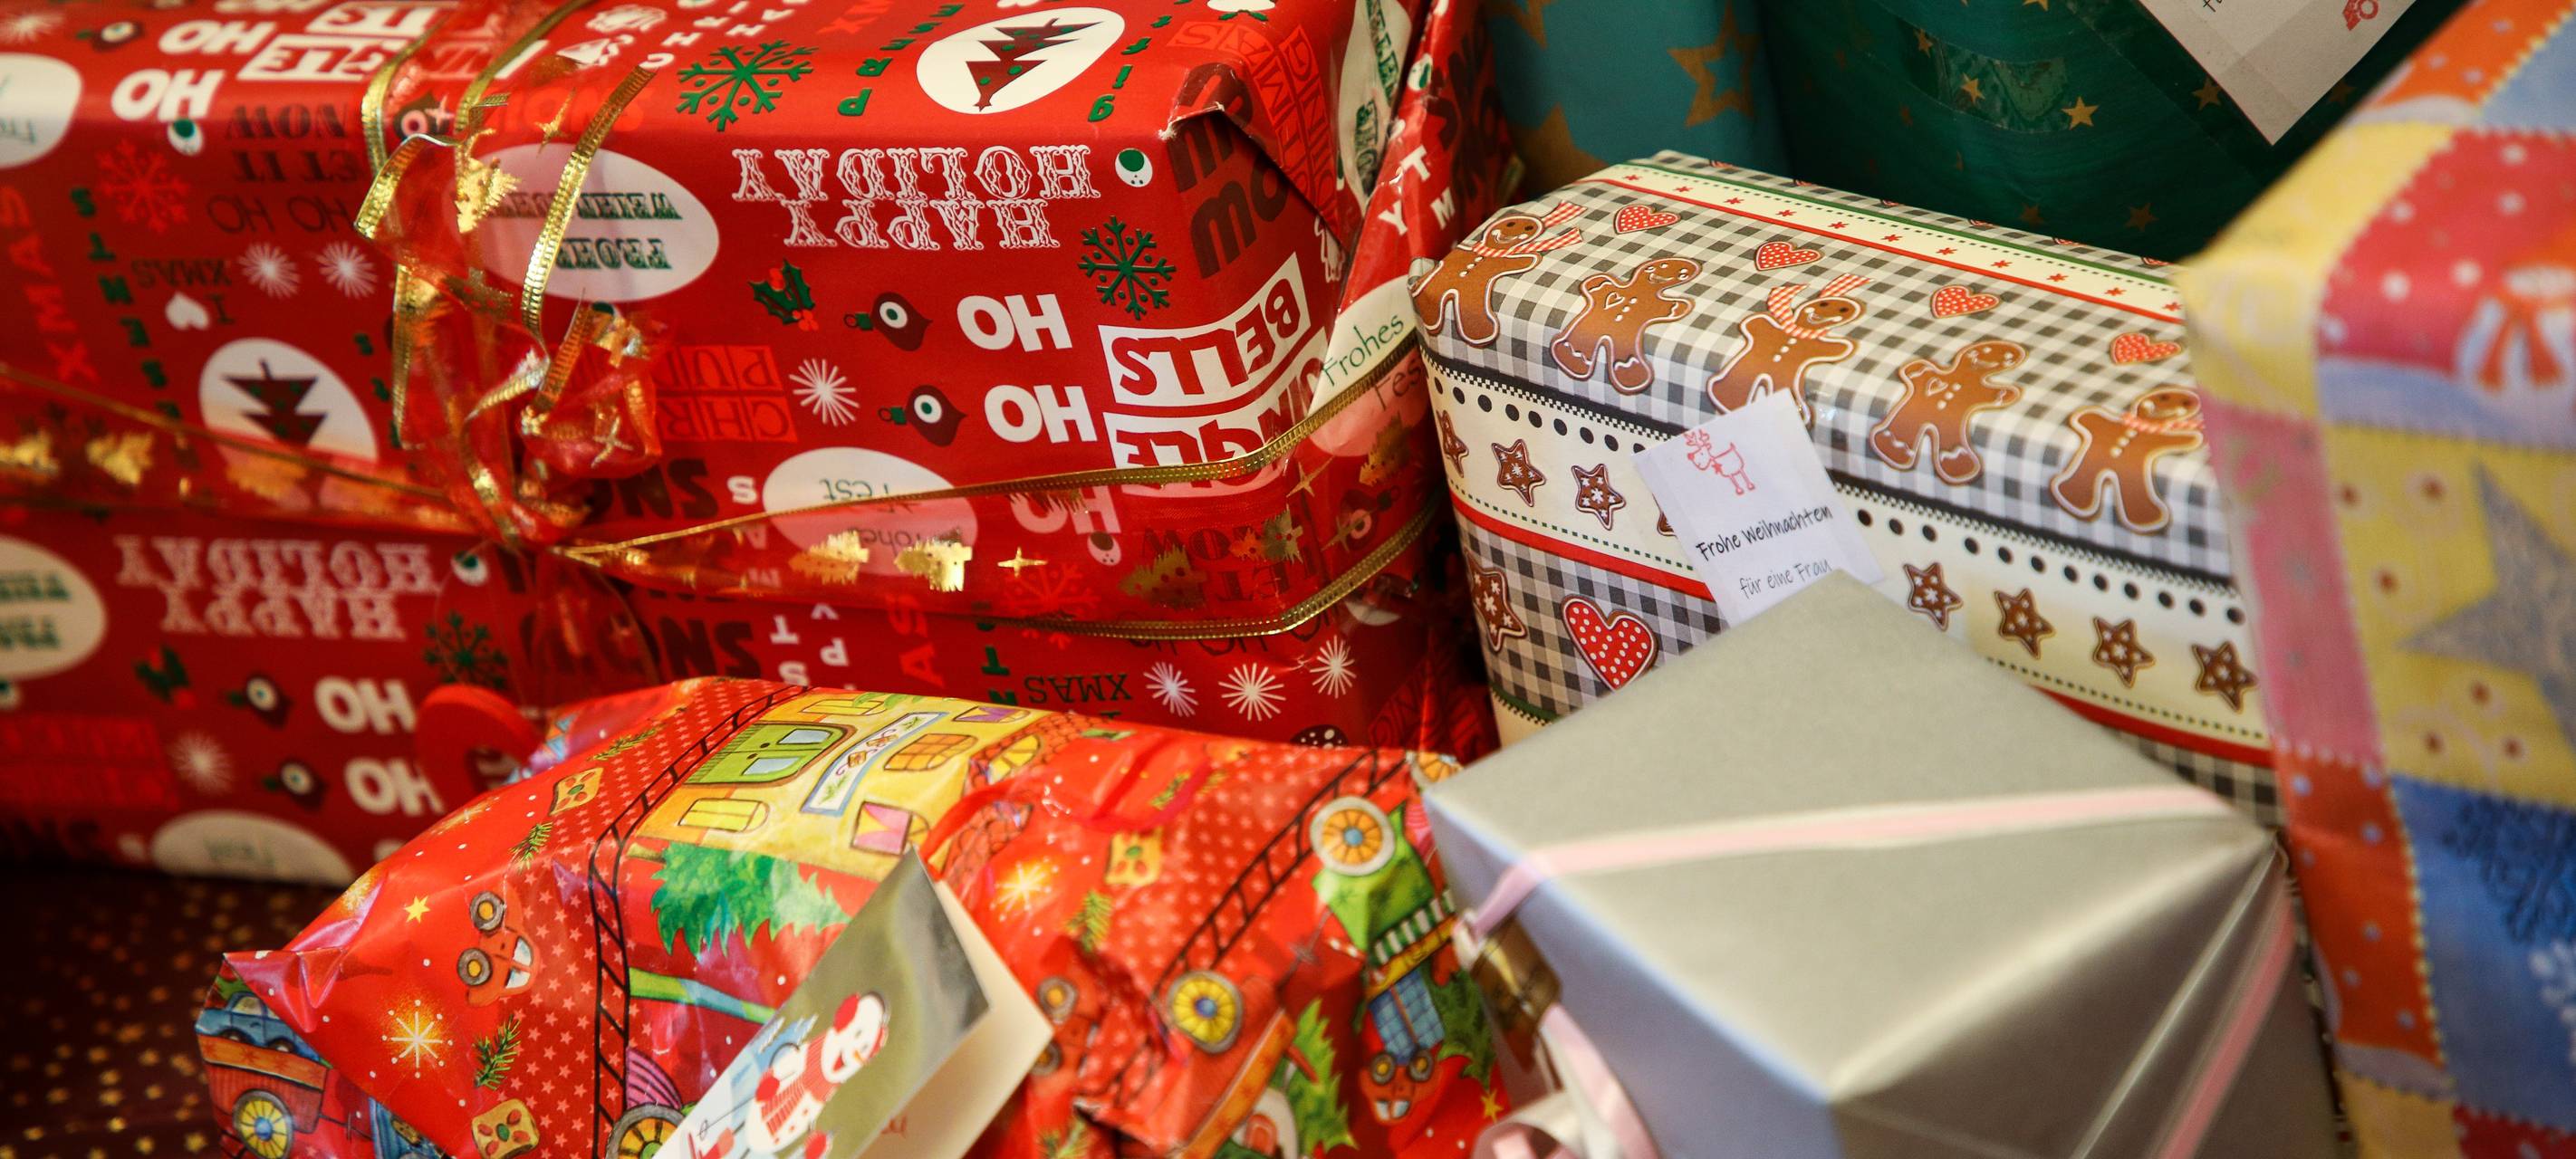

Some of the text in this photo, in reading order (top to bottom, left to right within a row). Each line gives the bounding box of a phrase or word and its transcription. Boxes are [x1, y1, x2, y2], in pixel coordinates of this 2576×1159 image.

[731, 144, 1101, 202] HOLIDAY
[780, 198, 1061, 252] HAPPY
[956, 293, 1073, 353] HO
[1110, 281, 1302, 397] BELLS
[984, 384, 1098, 444] HO
[1696, 504, 1833, 562] Frohe Weihnachten
[113, 534, 443, 594] HOLIDAY
[1739, 558, 1833, 599] für eine Frau
[159, 584, 406, 640] HAPPY
[1023, 672, 1131, 704] XMAS
